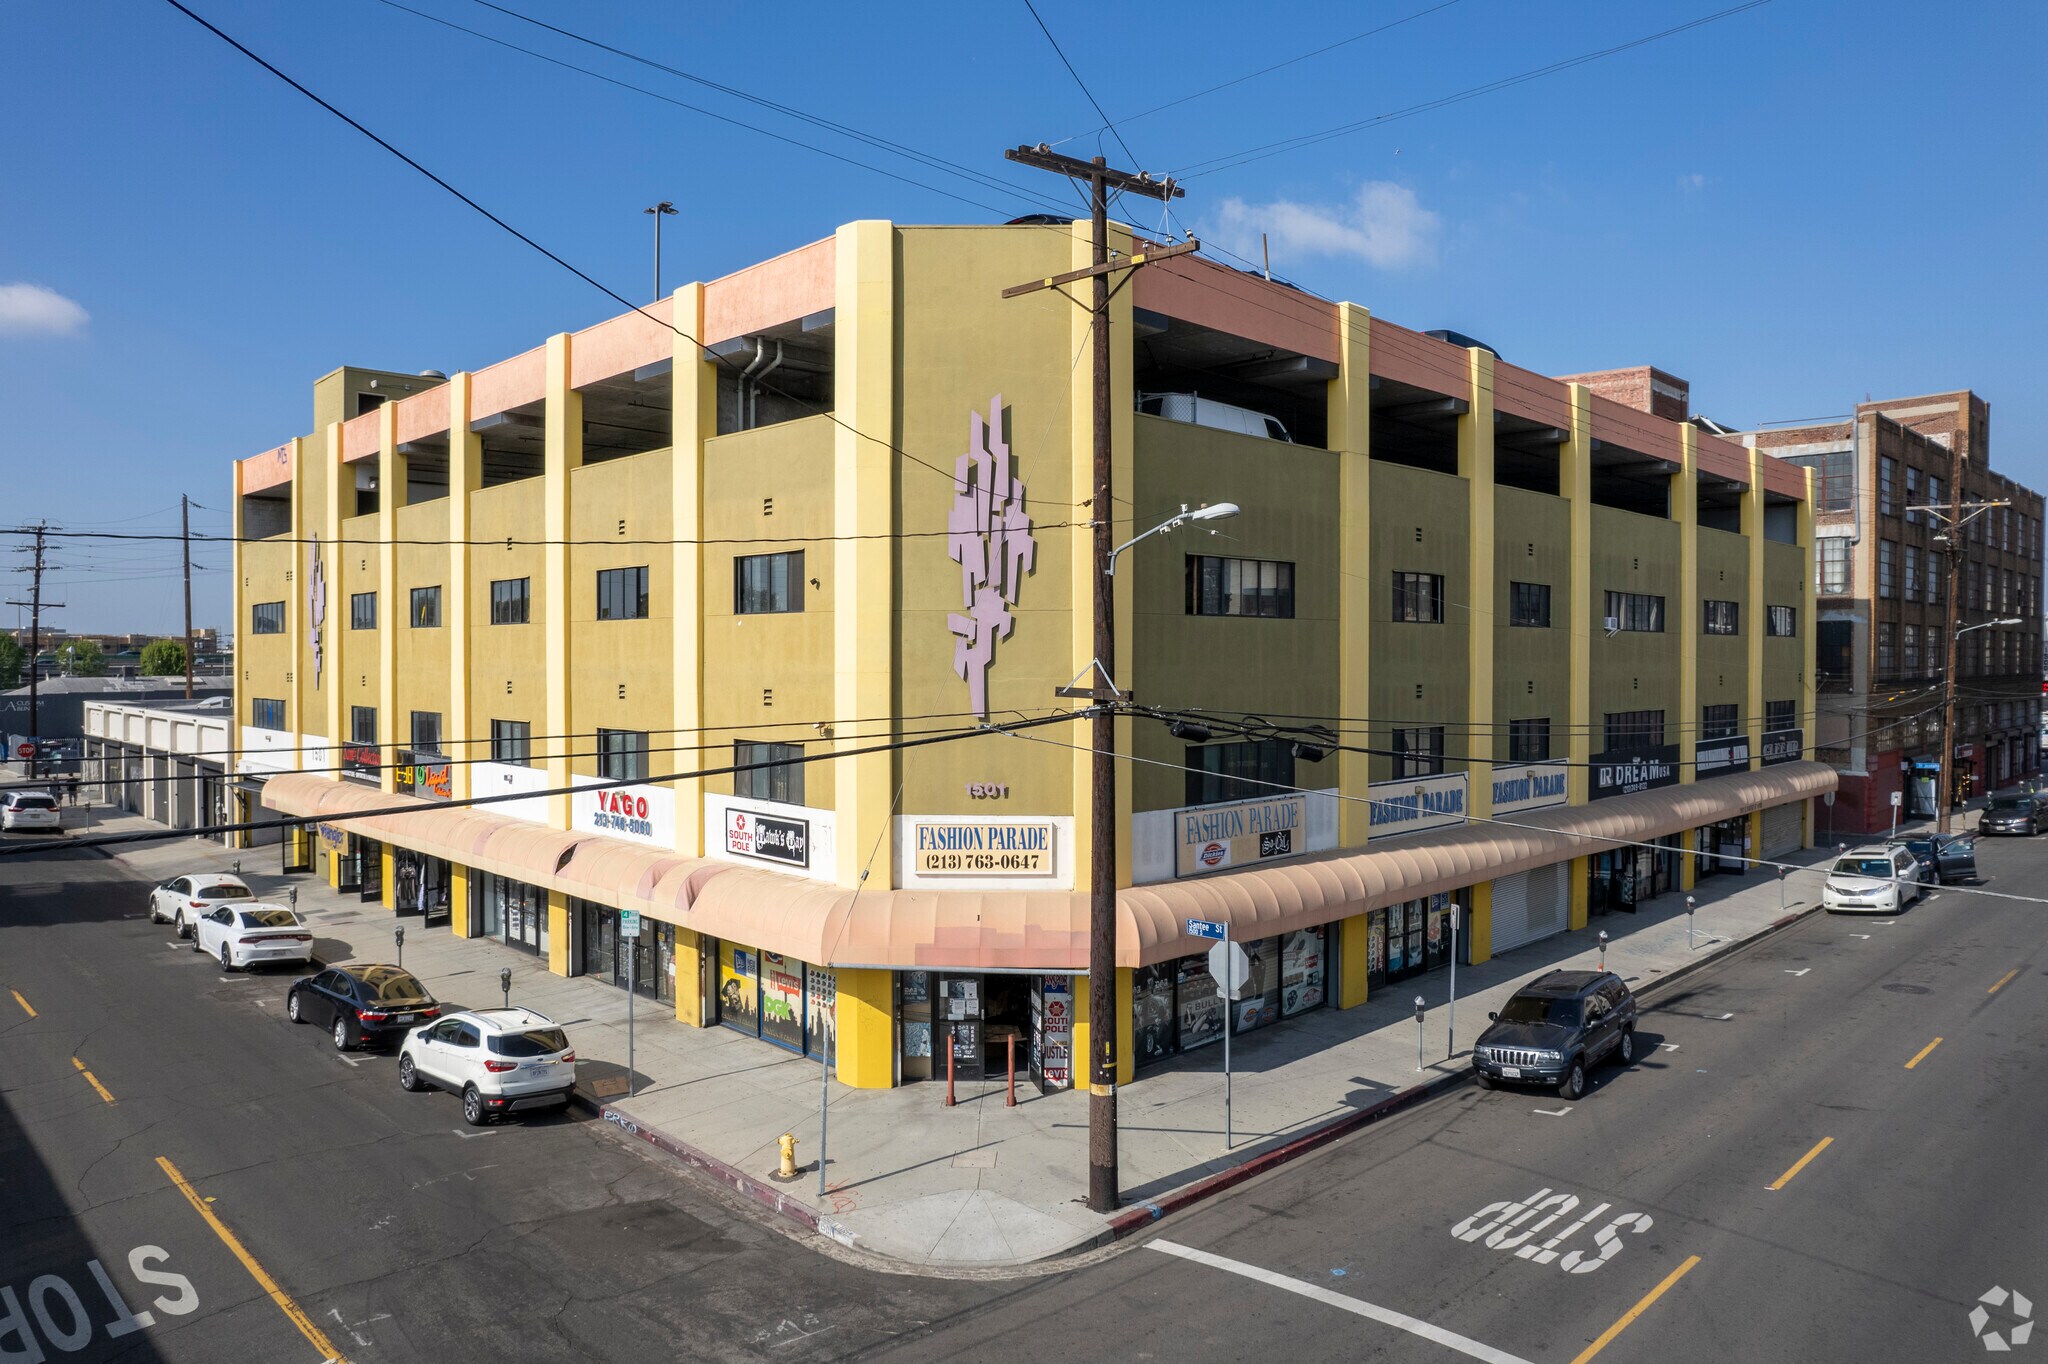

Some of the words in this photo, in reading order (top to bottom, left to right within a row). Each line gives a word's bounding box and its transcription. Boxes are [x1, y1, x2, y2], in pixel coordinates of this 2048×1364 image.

[1615, 759, 1659, 786] DREAM
[964, 781, 1005, 796] 1501
[1492, 779, 1530, 804] FASHION
[1532, 773, 1565, 797] PARADE
[598, 791, 649, 819] YAGO
[1370, 795, 1418, 826] FASHION
[1422, 789, 1463, 817] PARADE
[729, 830, 753, 842] SOUTH
[1186, 810, 1243, 845] FASHION
[1248, 802, 1299, 834] PARADE
[732, 841, 750, 852] POLE
[919, 826, 984, 851] FASHION
[988, 826, 1048, 851] PARADE
[926, 854, 962, 870] (213)
[965, 854, 1039, 870] 763-0647
[1189, 920, 1210, 931] Santee
[1215, 924, 1222, 934] St
[1451, 1188, 1654, 1274] STOP
